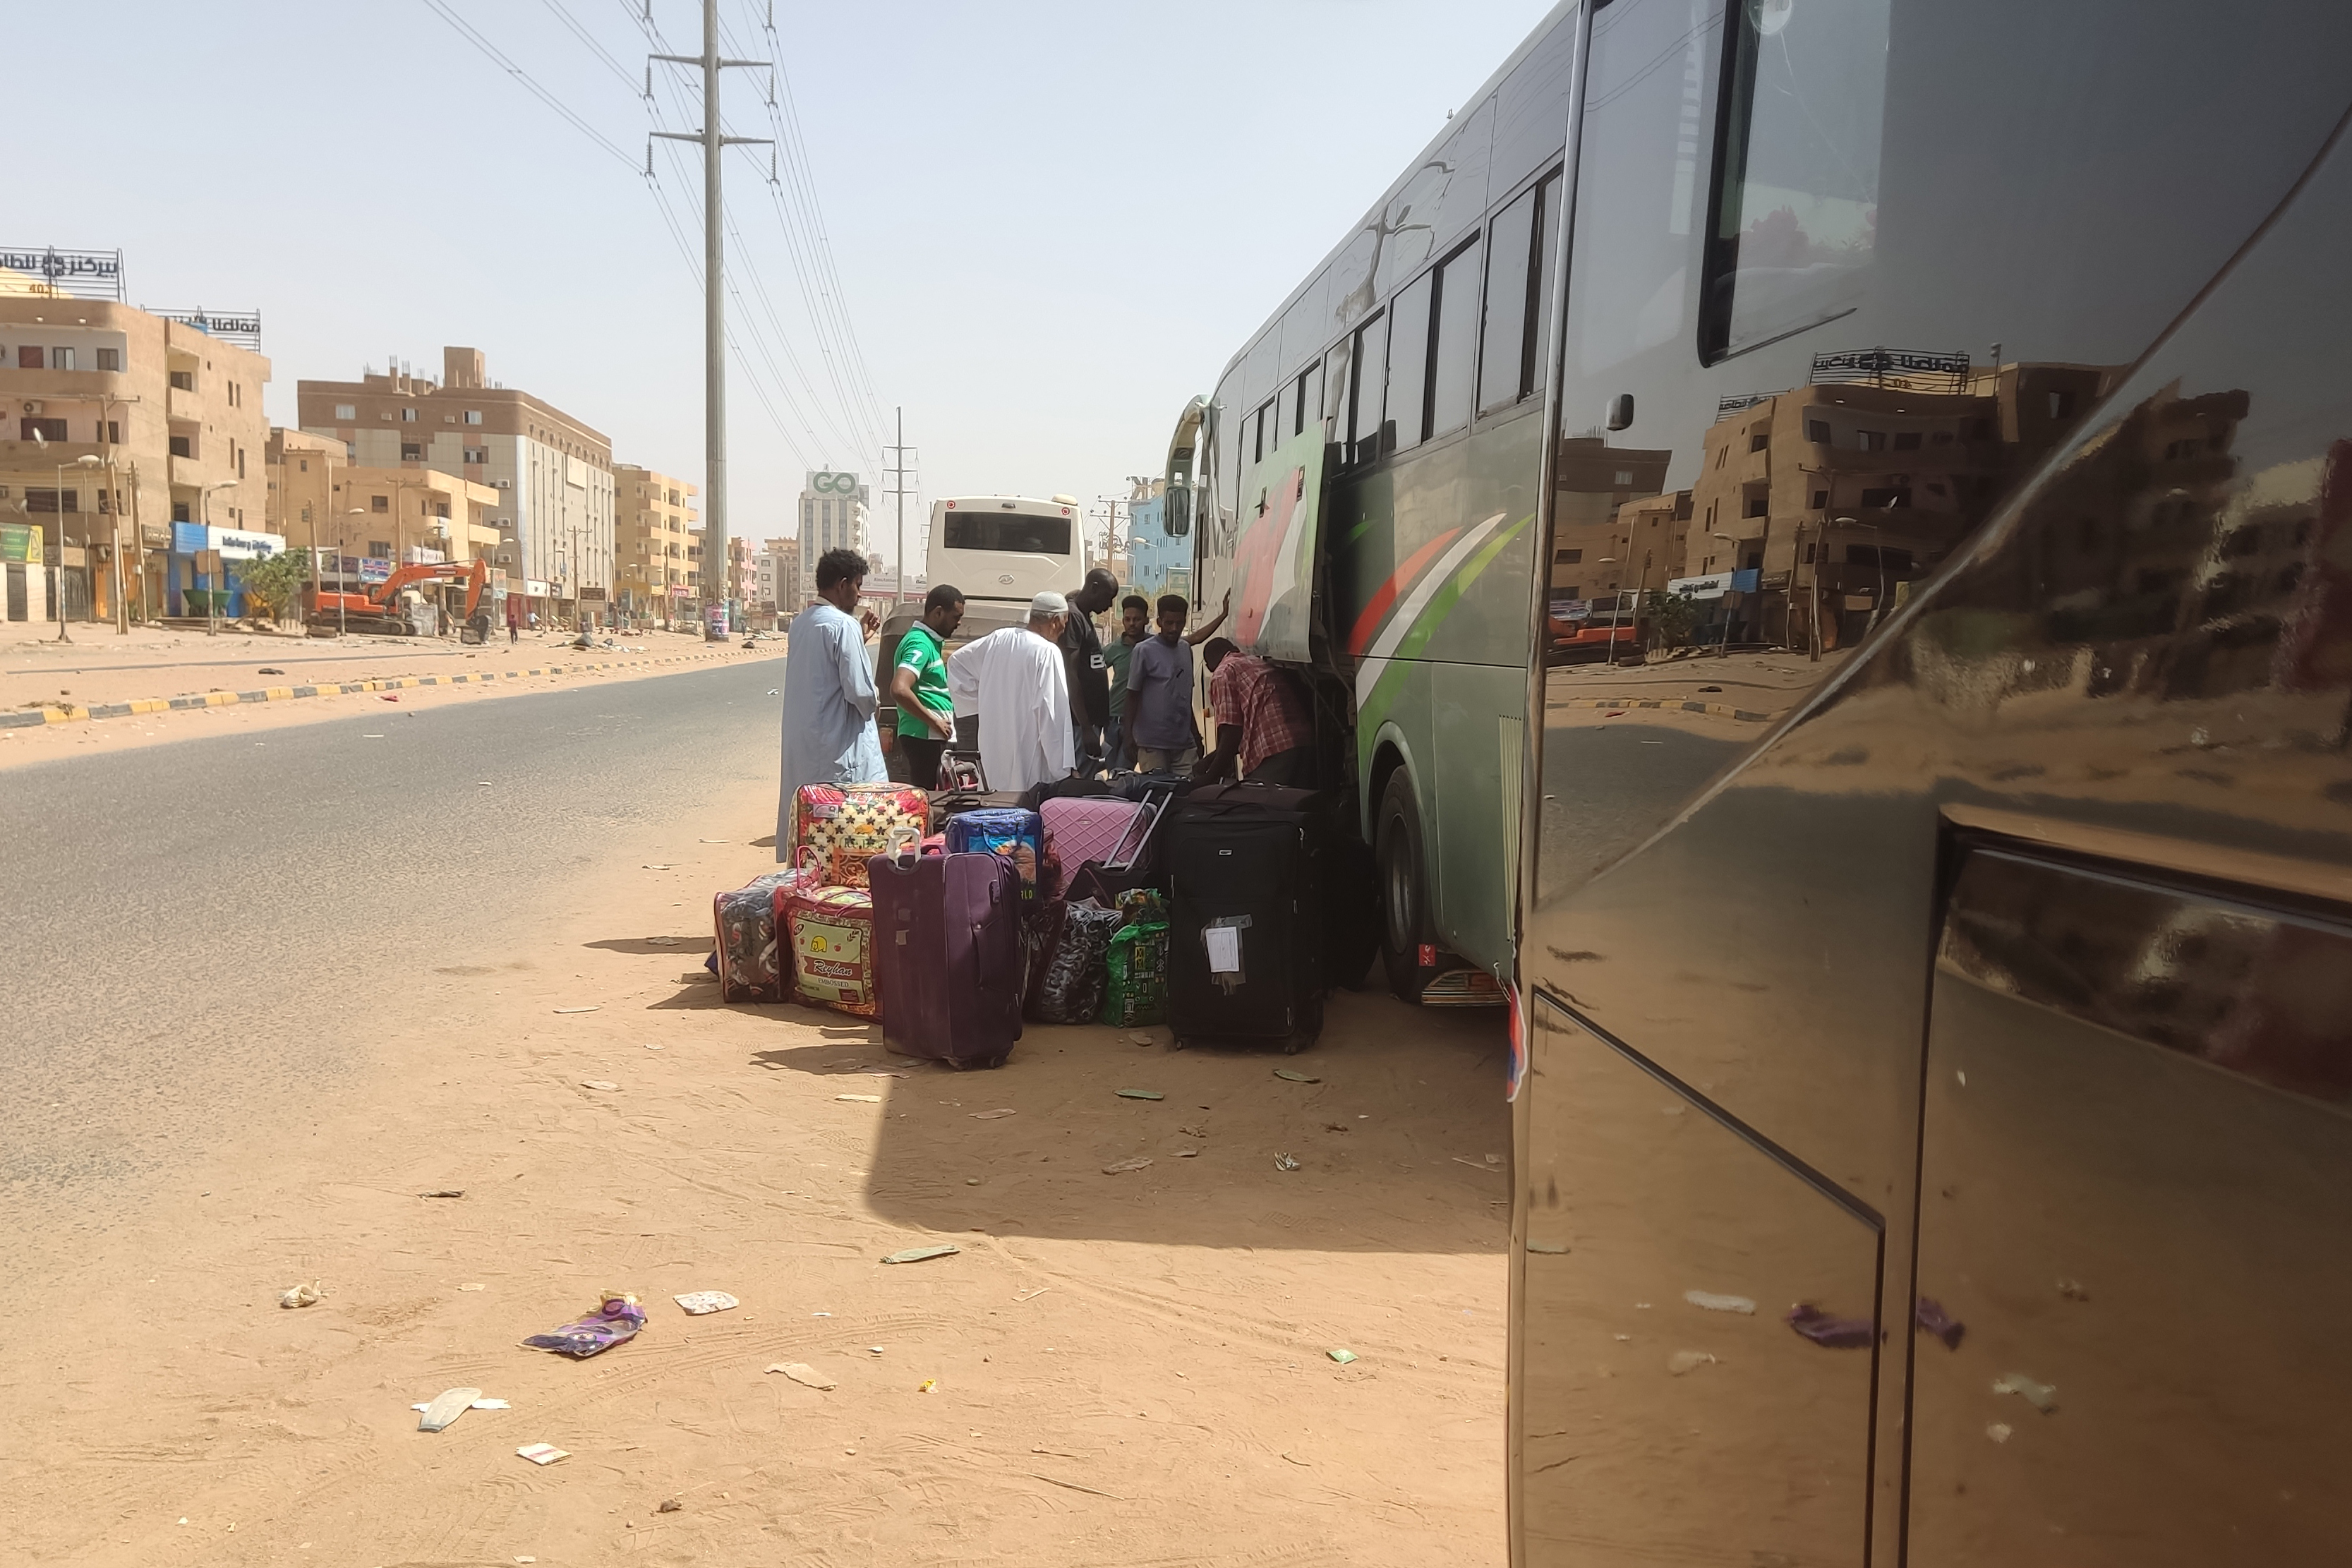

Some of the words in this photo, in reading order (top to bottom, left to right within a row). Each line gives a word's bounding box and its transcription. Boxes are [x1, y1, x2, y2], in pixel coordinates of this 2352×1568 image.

[0, 253, 35, 269] للطا
[813, 471, 856, 494] GO
[814, 959, 852, 977] Reyhan
[818, 977, 849, 988] EMBOSSED
